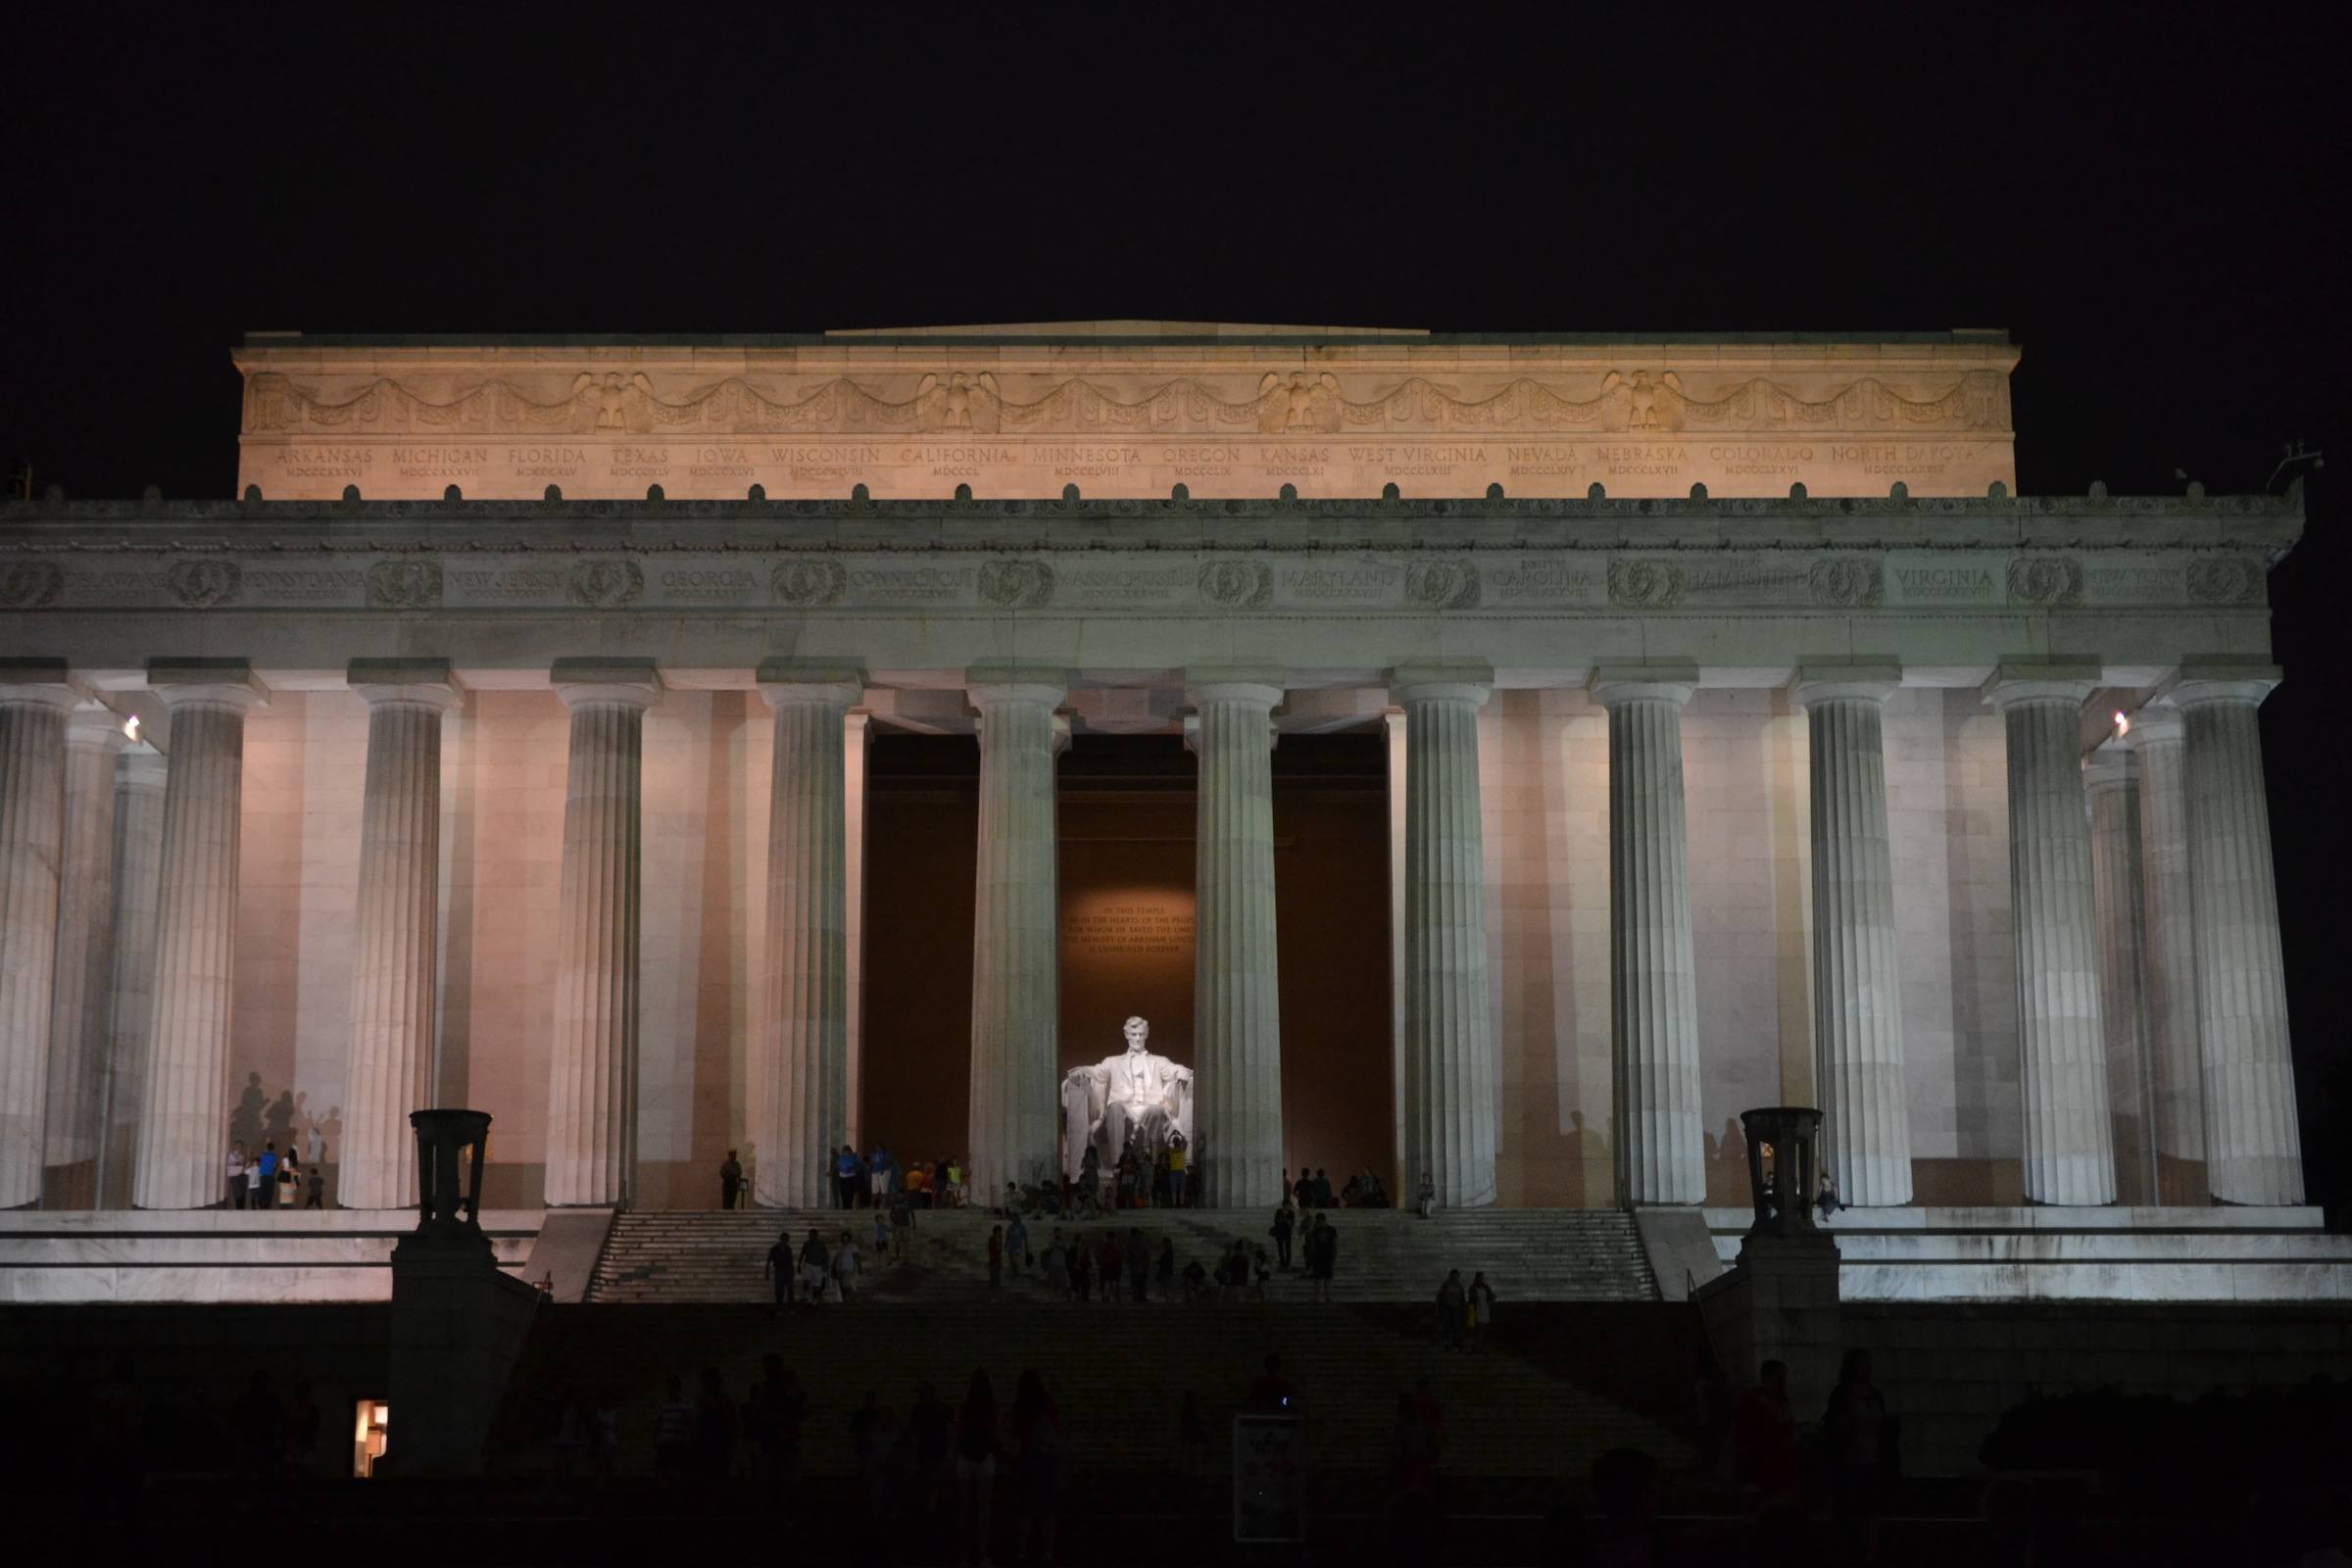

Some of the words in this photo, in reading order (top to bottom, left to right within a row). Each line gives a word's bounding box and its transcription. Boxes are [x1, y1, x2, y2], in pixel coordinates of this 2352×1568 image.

[275, 448, 372, 464] ARKANSAS
[392, 448, 487, 464] MICHIGAN
[510, 448, 586, 464] FLORIDA
[612, 448, 668, 464] TEXAS
[697, 448, 748, 464] IOWA
[771, 448, 880, 464] WISCONSIN
[901, 448, 1012, 463] CALIFORNIA
[1034, 448, 1142, 463] MINNESOTA
[1163, 447, 1240, 463] OREGON
[1261, 447, 1330, 463] KANSAS
[1348, 447, 1396, 463] WEST
[1403, 447, 1488, 463] VIRGINIA
[1506, 446, 1579, 462] NEVADA
[1597, 446, 1689, 462] NEBRASKA
[1709, 446, 1814, 462] COLORADO
[1833, 446, 1896, 461] NORTH
[1906, 446, 1976, 461] DAKOTA
[933, 466, 980, 476] MDCCCL
[662, 571, 759, 587] GEORGIA
[1894, 569, 1995, 587] VIRGINIA
